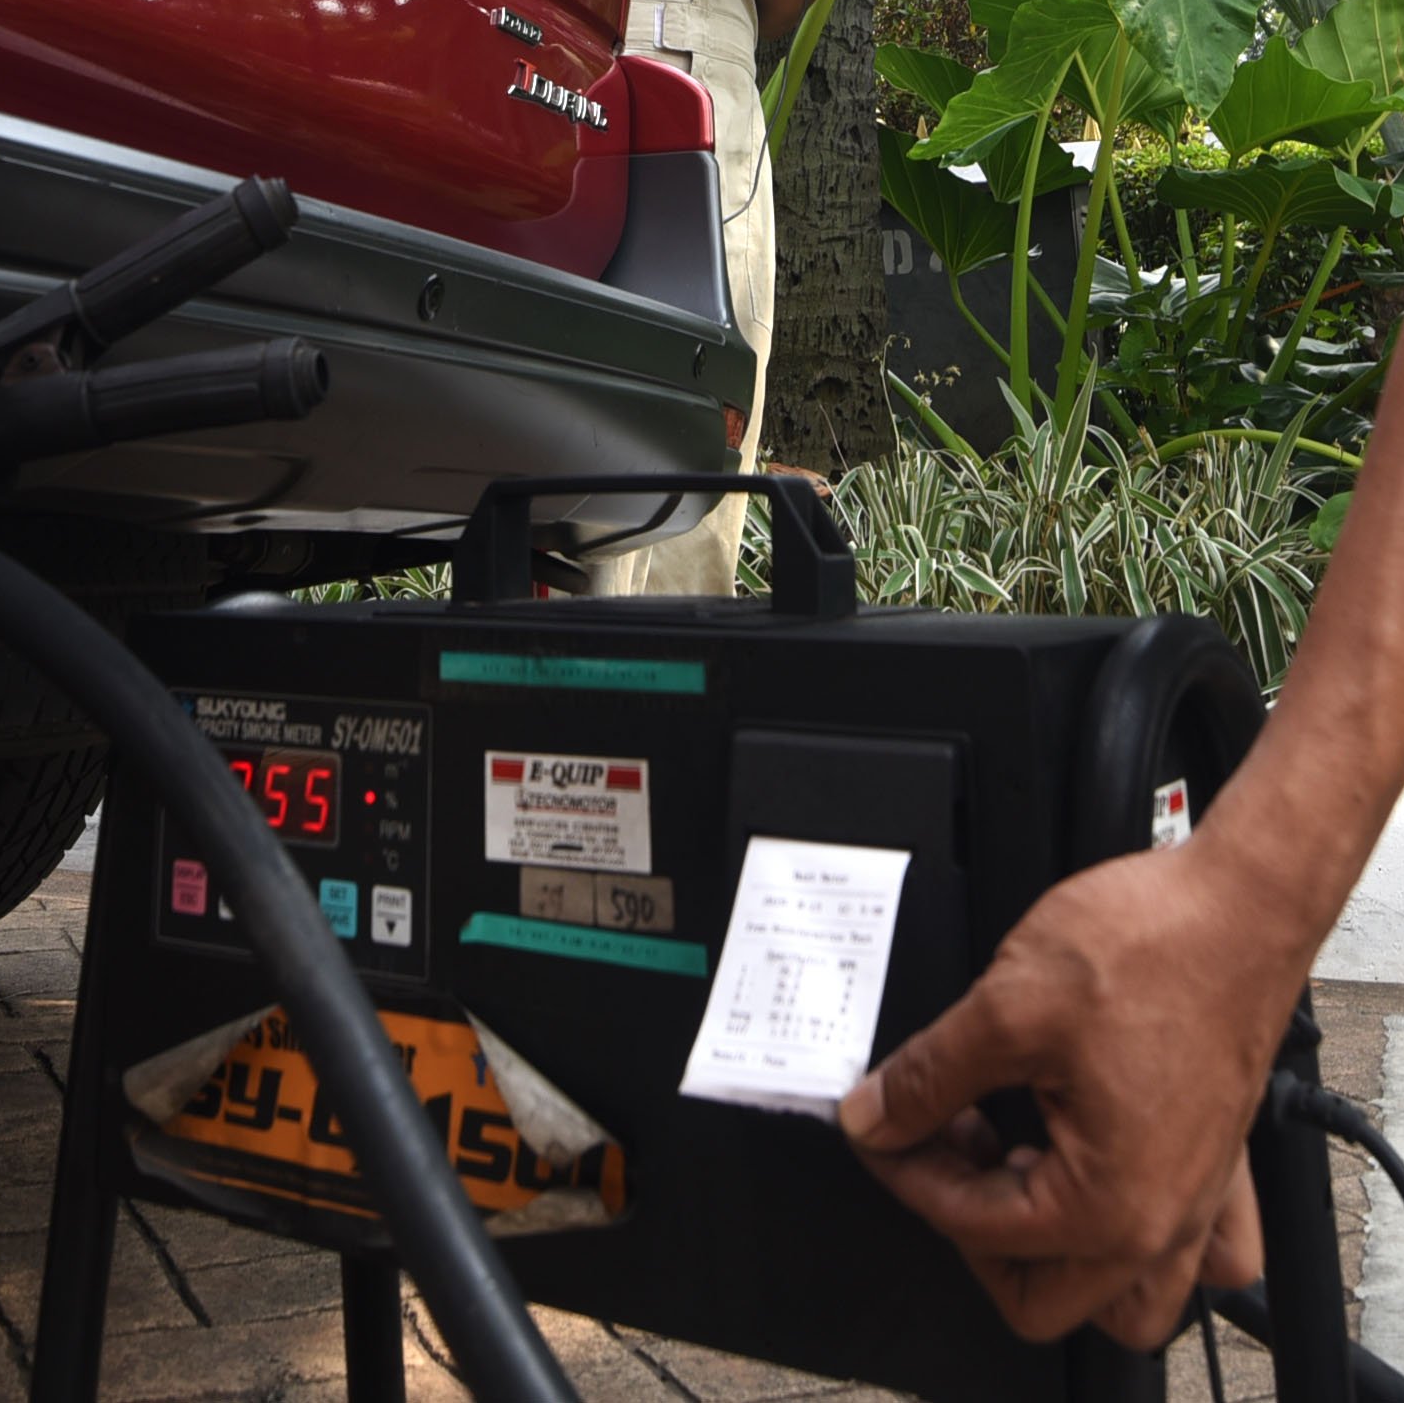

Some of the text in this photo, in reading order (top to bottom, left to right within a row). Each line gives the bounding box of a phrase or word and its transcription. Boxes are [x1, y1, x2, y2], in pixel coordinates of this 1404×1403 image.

[241, 720, 279, 743] SMOKE
[283, 724, 323, 745] METER
[529, 759, 605, 789] E-QUIP
[379, 819, 412, 841] RPM
[377, 891, 407, 906] PRINT
